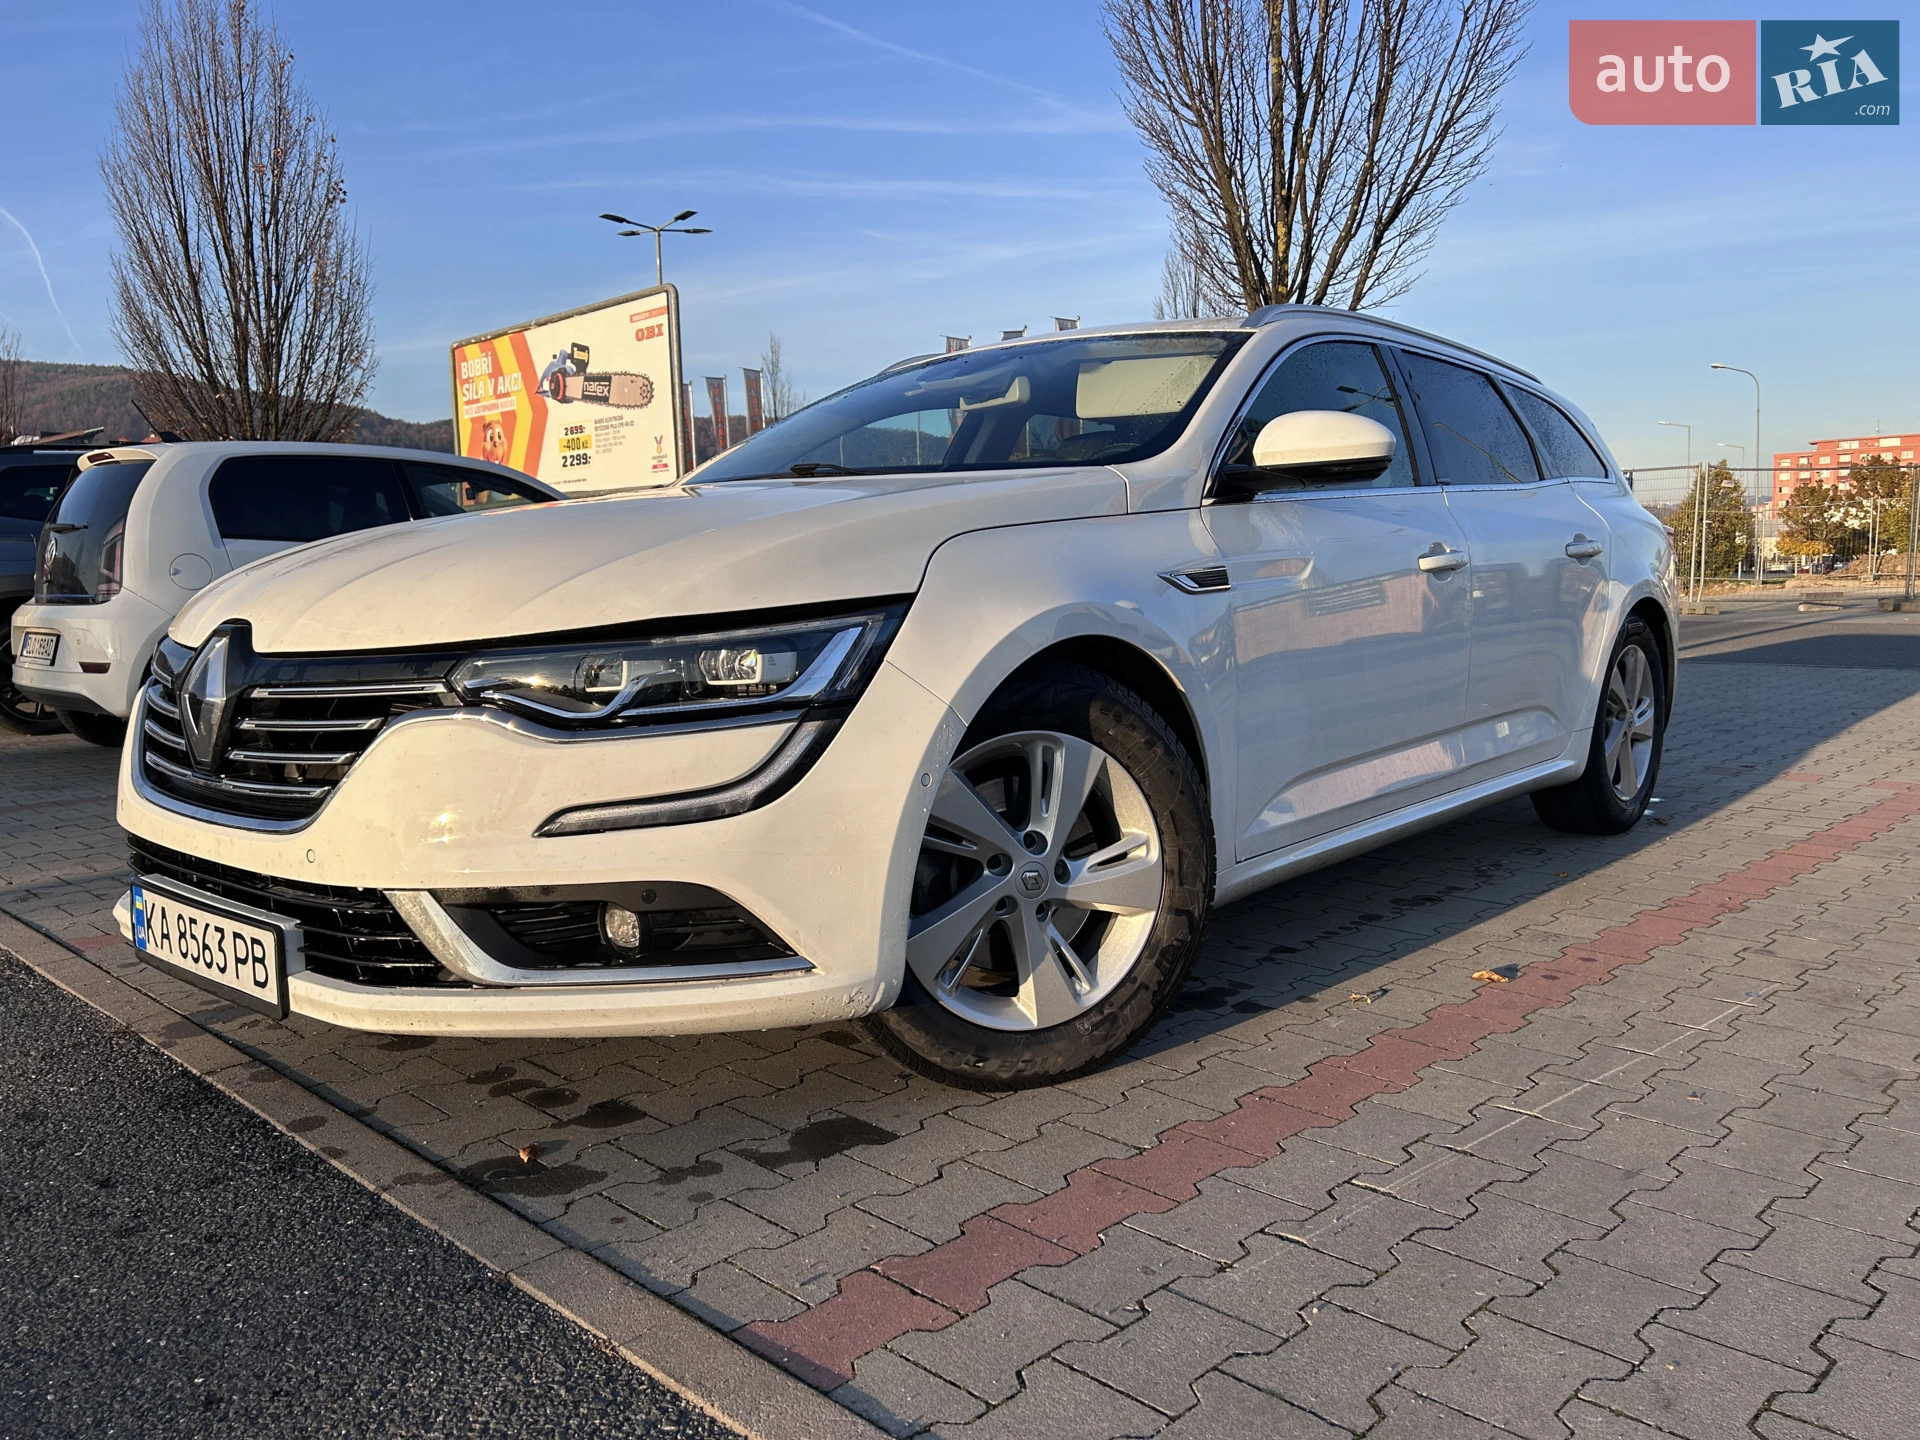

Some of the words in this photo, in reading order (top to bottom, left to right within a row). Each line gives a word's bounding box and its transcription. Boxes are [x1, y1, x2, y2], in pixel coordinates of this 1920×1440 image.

[635, 323, 664, 342] OBI
[461, 352, 492, 380] BOBŘÍ
[462, 379, 485, 402] SÍLA
[488, 378, 495, 396] V
[497, 372, 522, 395] AKCI
[584, 382, 610, 397] narex
[563, 437, 581, 451] -400
[582, 440, 588, 449] Kč
[137, 925, 146, 941] UA
[144, 899, 173, 954] KA
[176, 913, 228, 974] 8563
[232, 931, 269, 989] PB
